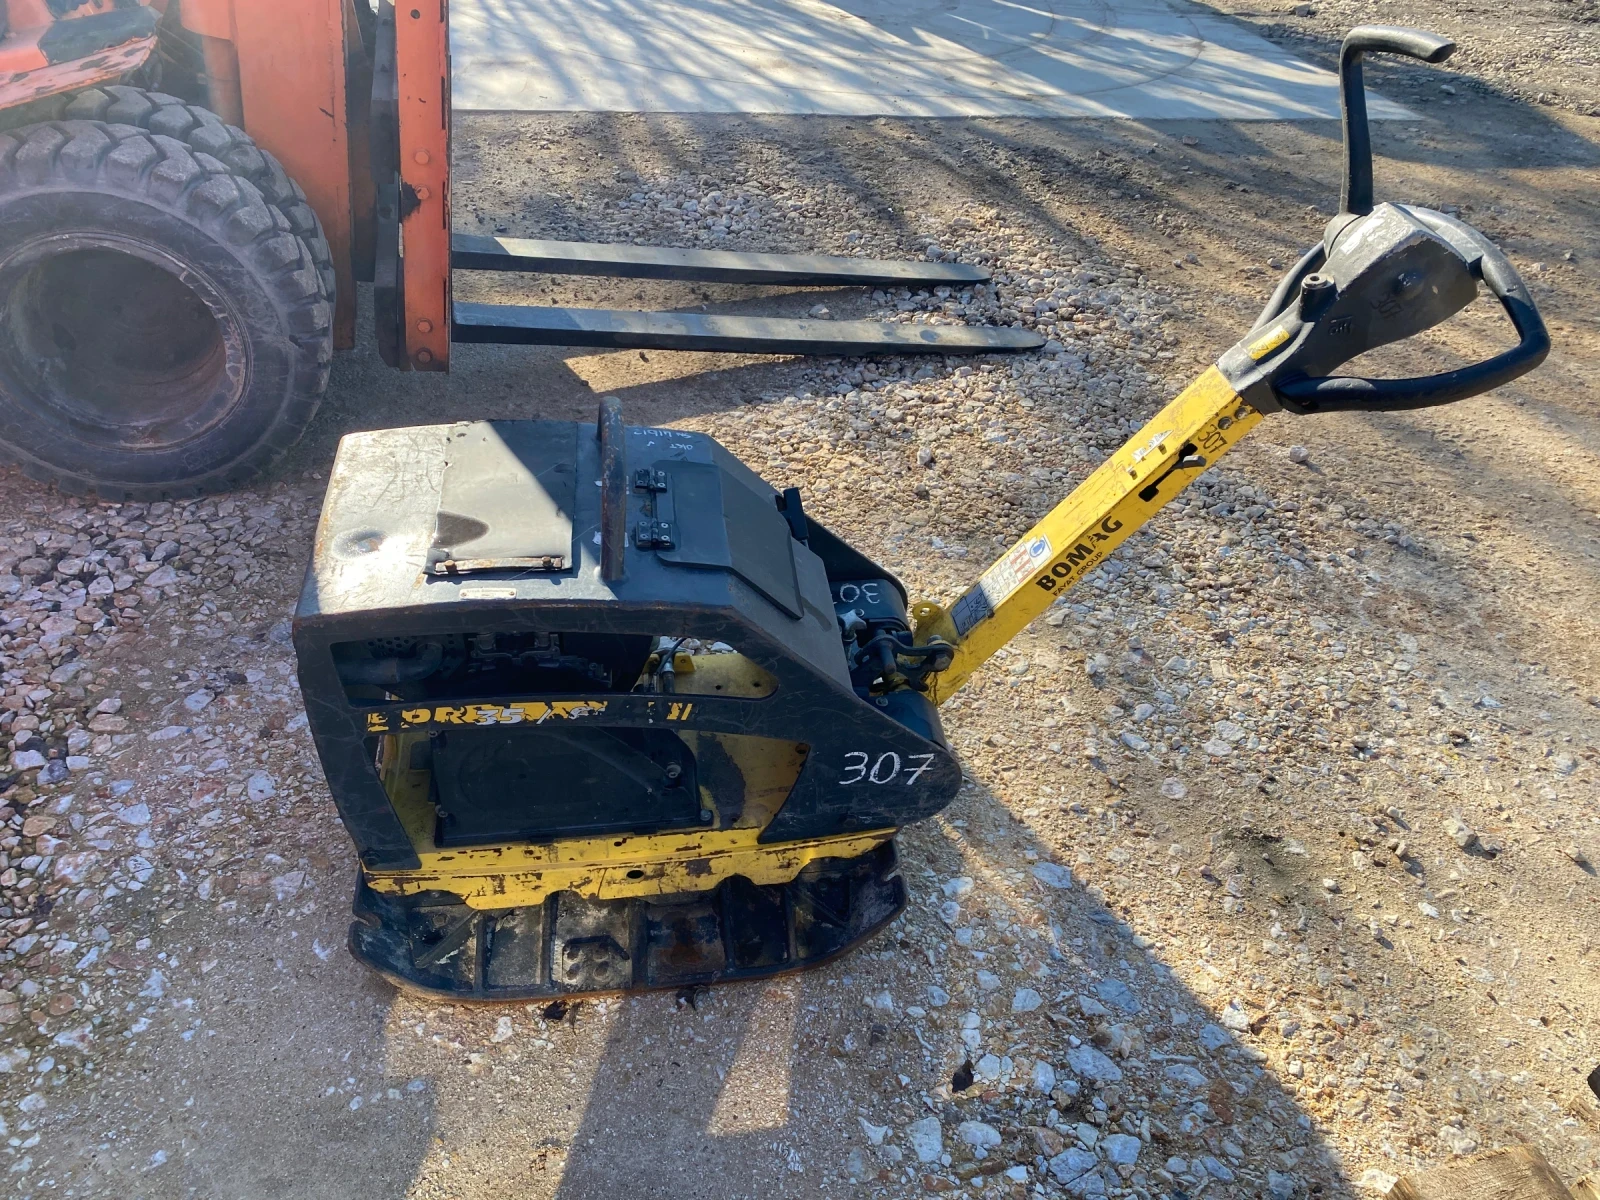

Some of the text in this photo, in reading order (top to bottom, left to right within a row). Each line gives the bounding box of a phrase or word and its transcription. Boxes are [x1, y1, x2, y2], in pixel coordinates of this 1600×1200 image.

[1198, 424, 1228, 454] 307
[1035, 515, 1123, 591] BOMAG
[1052, 551, 1103, 596] FAYAT GROUP
[833, 583, 880, 604] 30
[838, 751, 935, 785] 307
